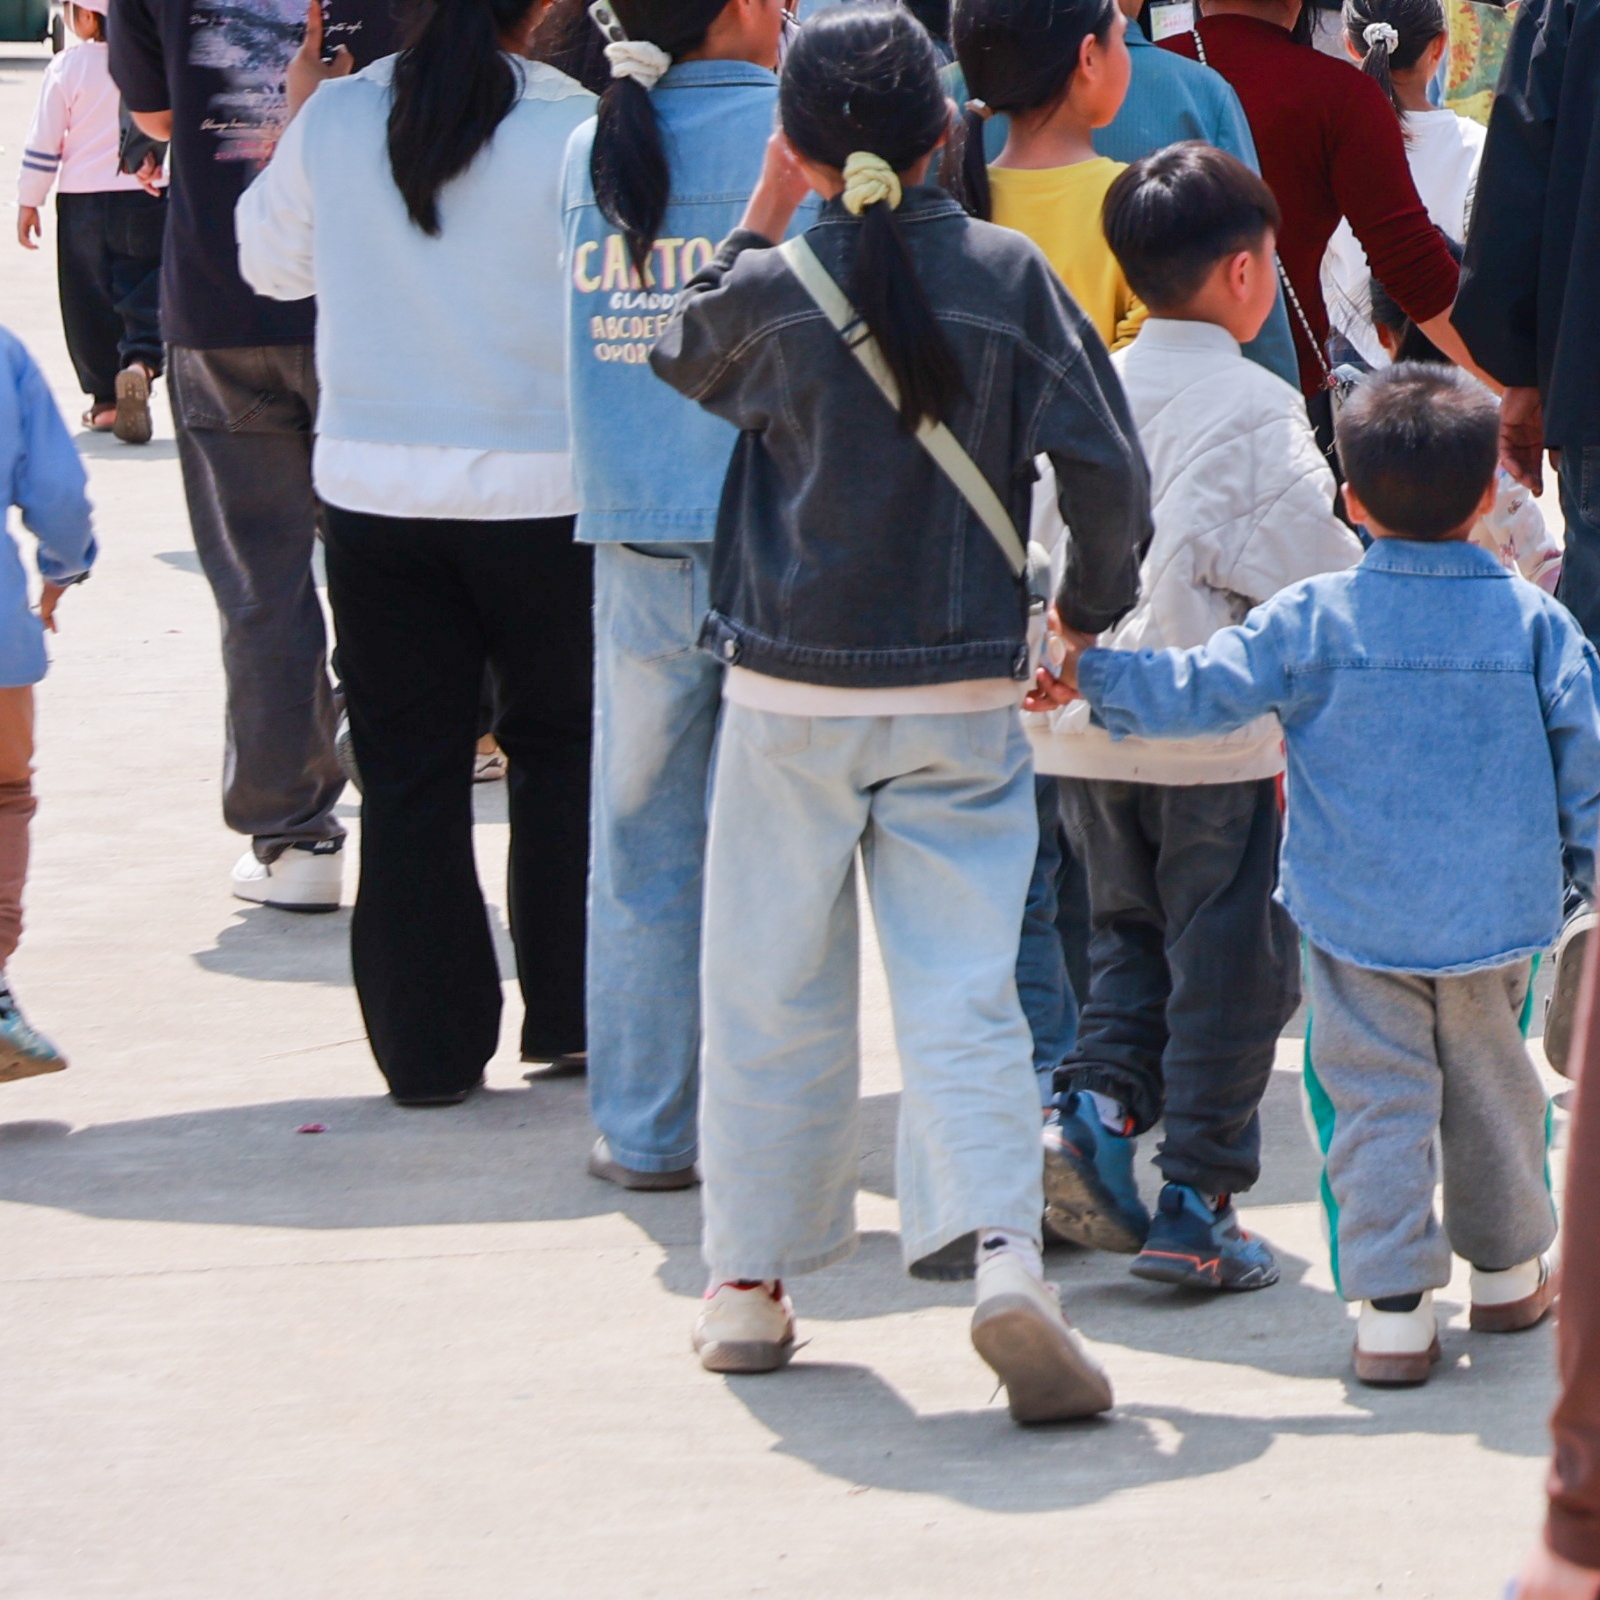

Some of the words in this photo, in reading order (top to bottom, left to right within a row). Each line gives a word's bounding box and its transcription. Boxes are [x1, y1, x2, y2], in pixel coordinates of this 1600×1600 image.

[573, 232, 721, 293] CATO
[609, 292, 680, 310] GLADD
[590, 313, 676, 340] ABCDEF
